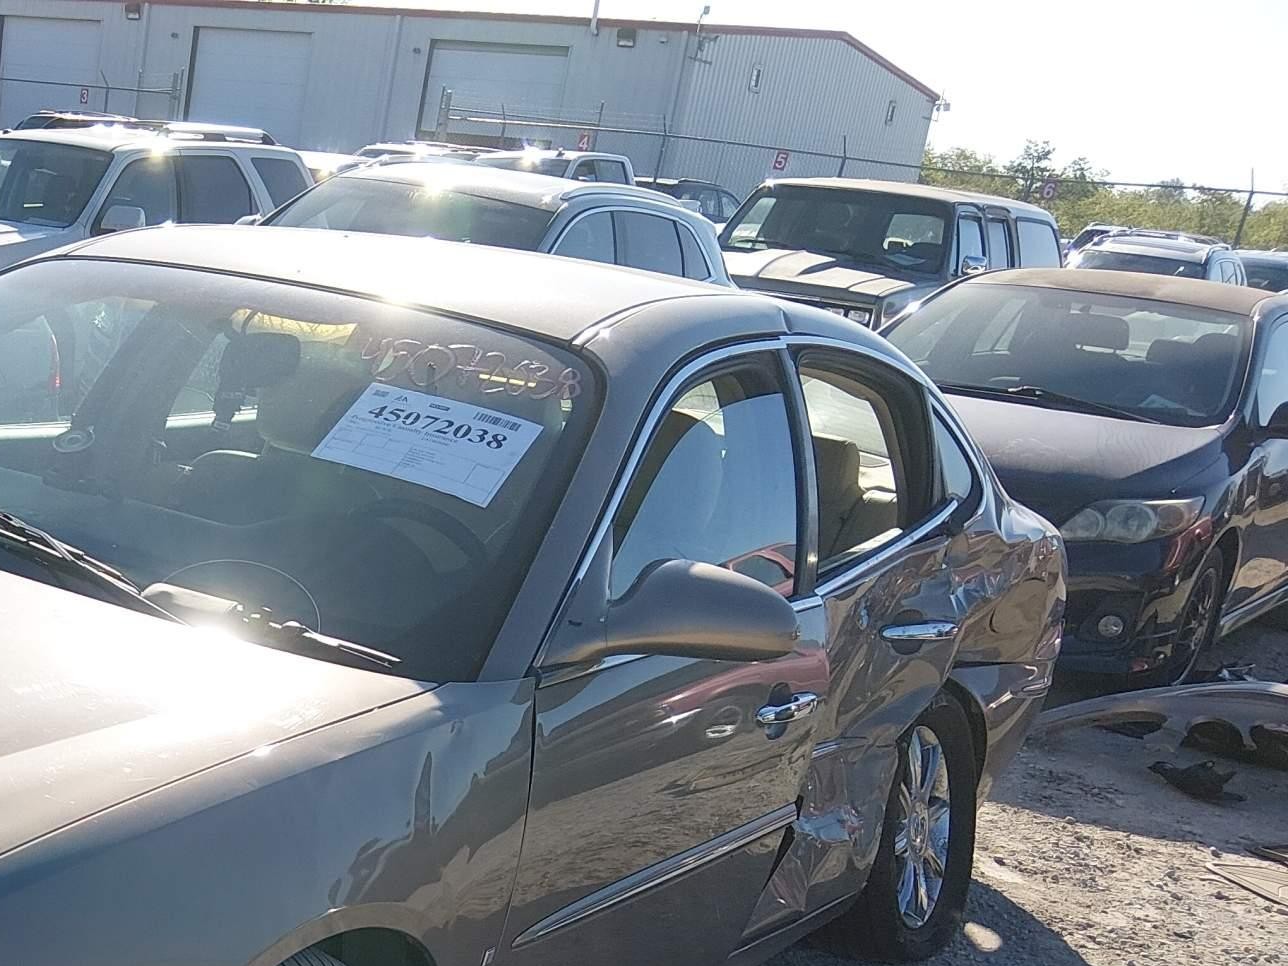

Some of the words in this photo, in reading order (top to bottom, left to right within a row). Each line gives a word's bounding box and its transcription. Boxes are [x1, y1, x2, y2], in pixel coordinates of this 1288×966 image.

[81, 90, 88, 103] 3
[579, 135, 589, 150] 4
[775, 154, 787, 168] 5
[1043, 183, 1056, 198] 6
[367, 404, 508, 450] 45072038
